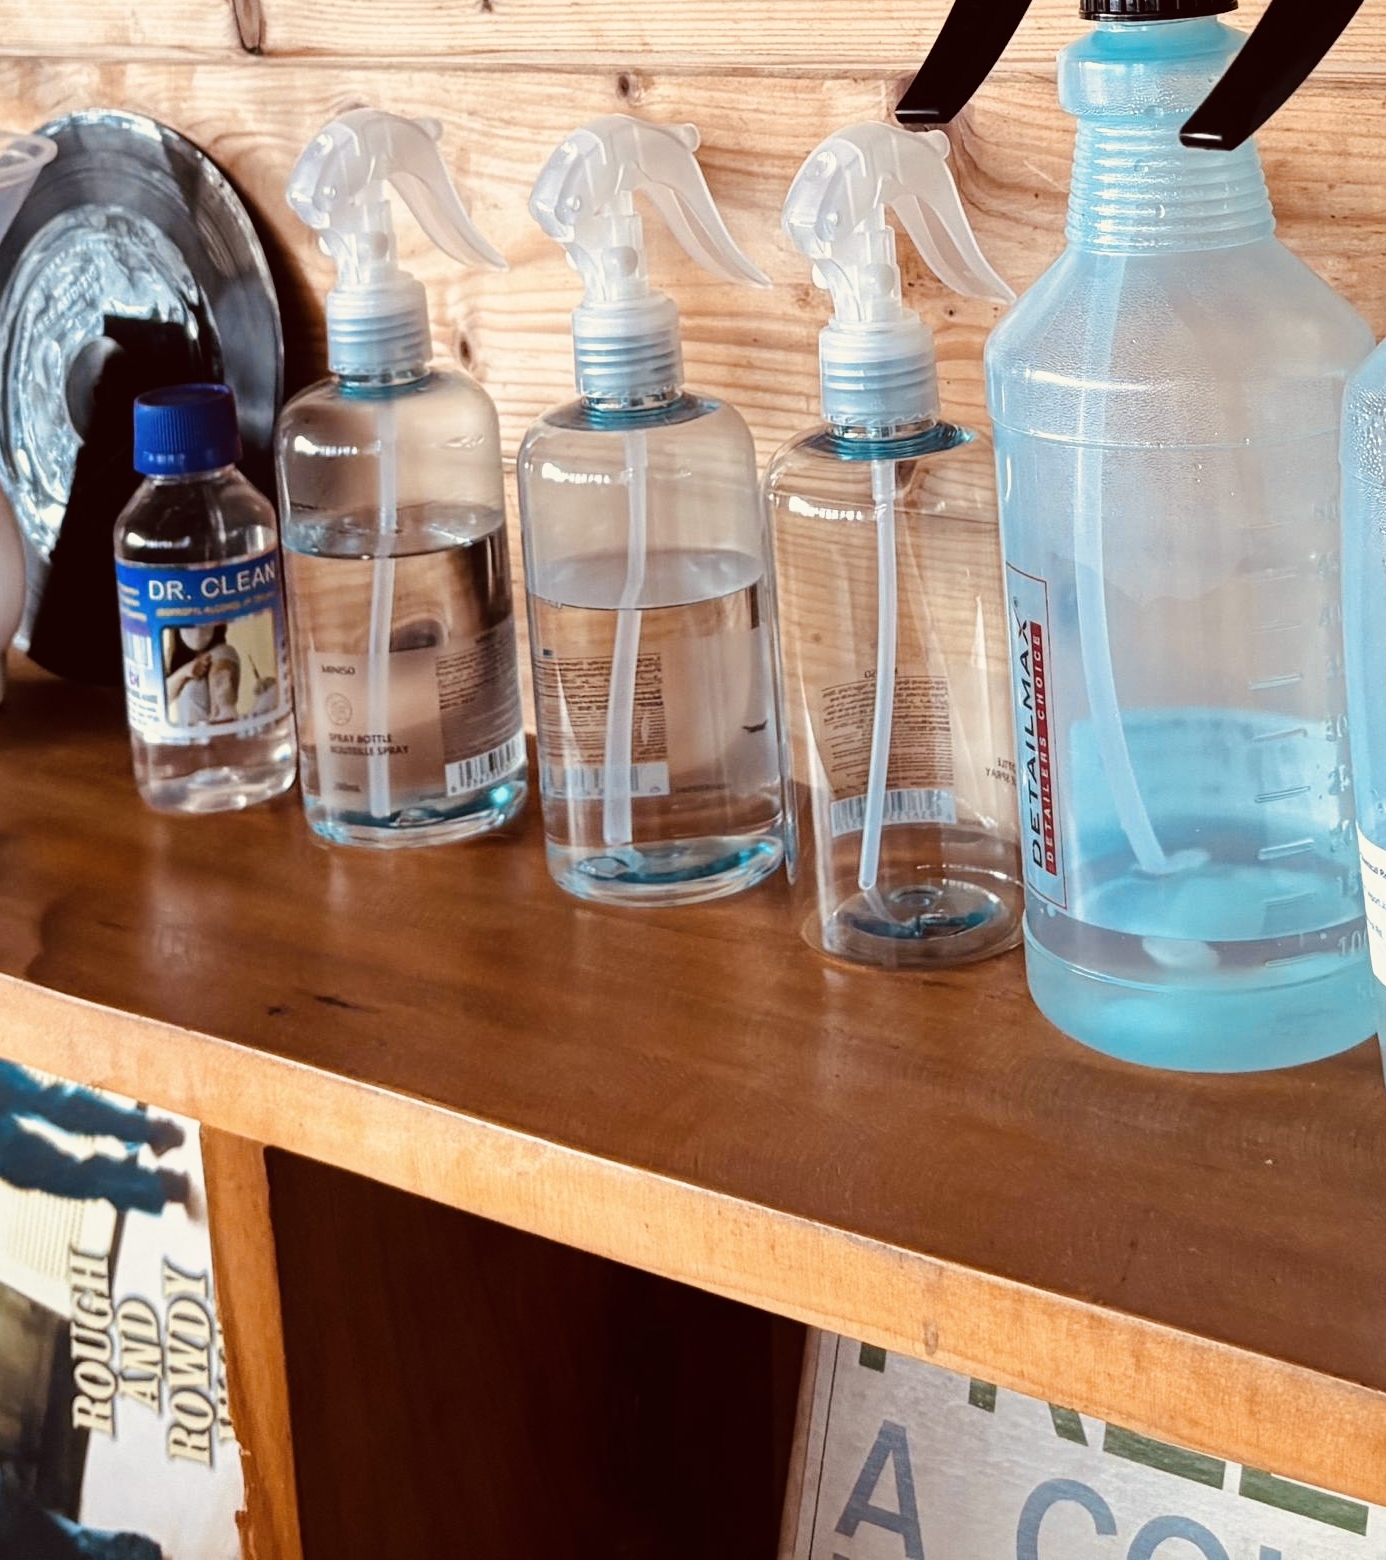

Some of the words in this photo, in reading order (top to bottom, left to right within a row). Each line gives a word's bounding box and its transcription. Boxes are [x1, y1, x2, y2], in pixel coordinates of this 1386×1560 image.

[148, 580, 192, 601] DR.
[201, 560, 276, 598] CLEAN
[322, 664, 355, 676] MINISO
[1032, 635, 1046, 721] CHOICE
[328, 733, 354, 743] SPRAY
[356, 733, 392, 744] BOTTLE
[374, 745, 409, 755] SPRAY
[1011, 603, 1043, 869] DETAILMAX
[1038, 735, 1054, 864] DETAILERS
[71, 1246, 117, 1441] ROUGH
[116, 1296, 163, 1419] AND
[164, 1254, 215, 1472] ROWDY
